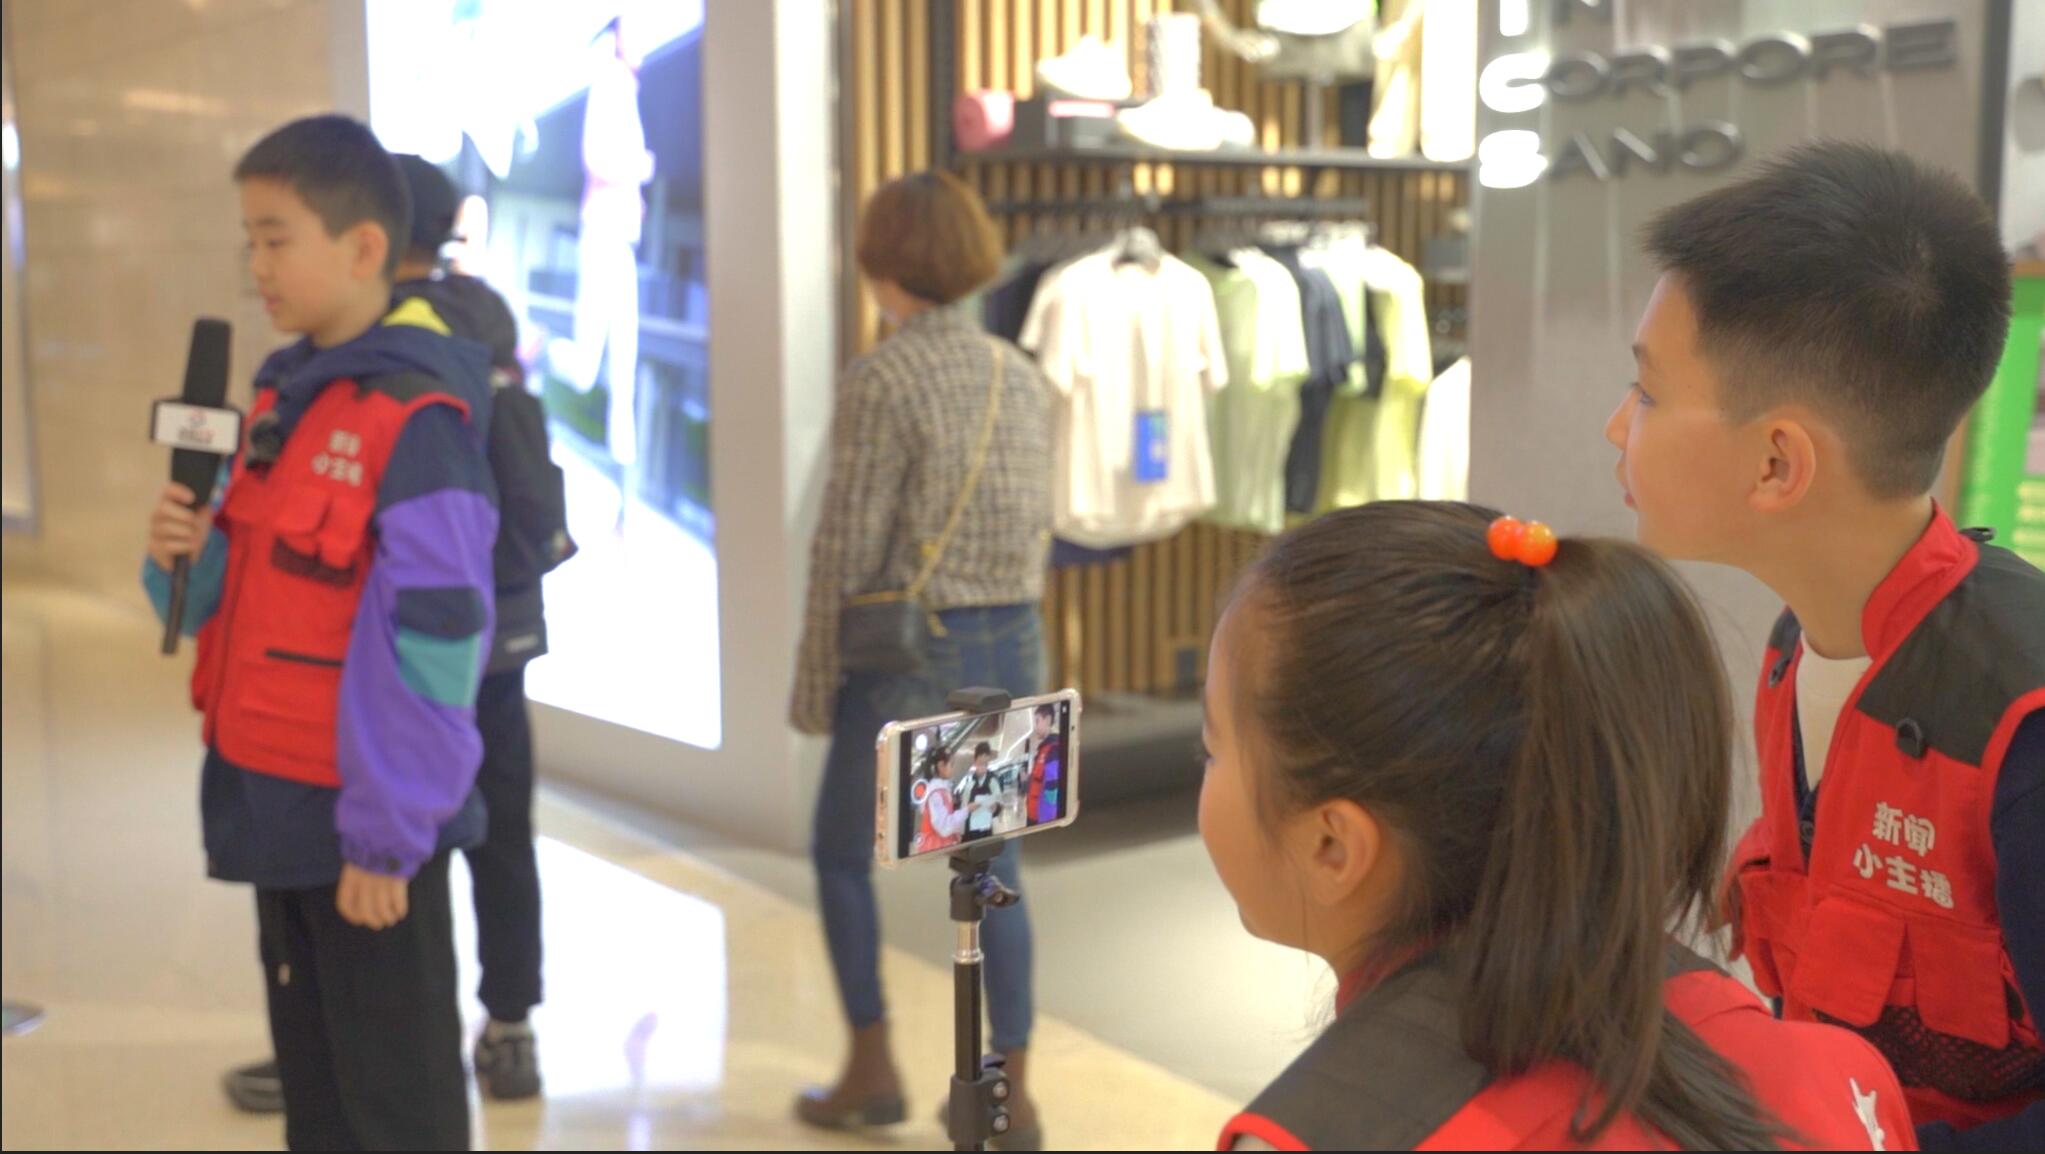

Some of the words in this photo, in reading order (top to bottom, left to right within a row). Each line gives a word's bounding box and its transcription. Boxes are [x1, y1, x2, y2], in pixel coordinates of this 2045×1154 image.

[1479, 18, 1957, 113] CORPORE
[1479, 121, 1743, 189] SANO
[1872, 801, 1936, 857] 新闻
[1853, 843, 1954, 909] 小主播
